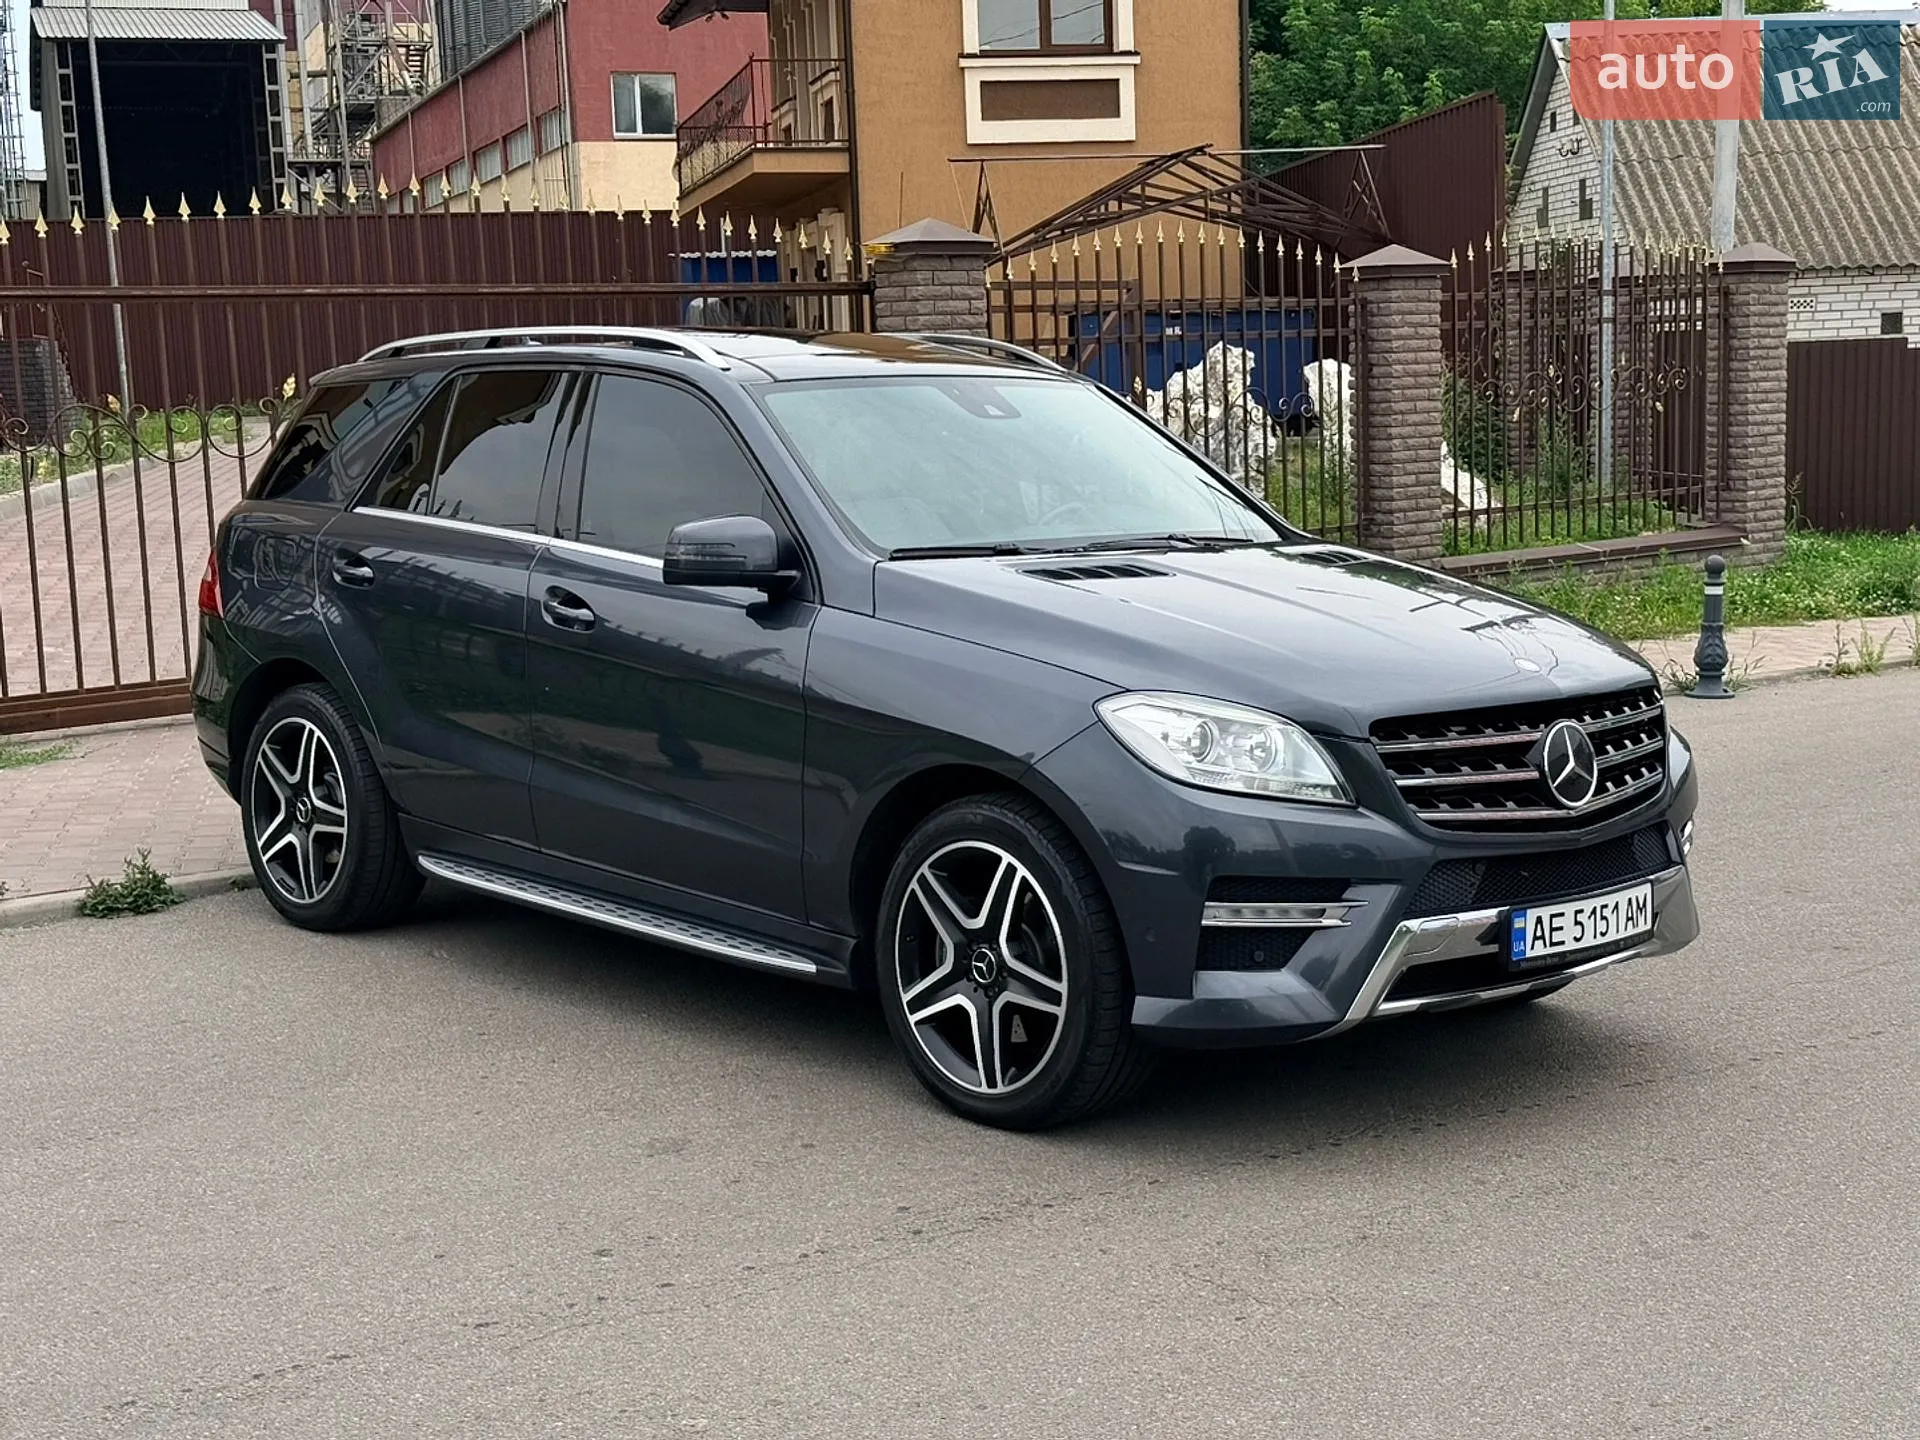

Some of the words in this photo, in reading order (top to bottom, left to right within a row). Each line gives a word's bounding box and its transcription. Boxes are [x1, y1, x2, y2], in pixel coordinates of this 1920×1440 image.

[1530, 912, 1566, 950] AE
[1573, 901, 1620, 943] 5151
[1624, 893, 1648, 931] AM
[1513, 940, 1525, 952] UA
